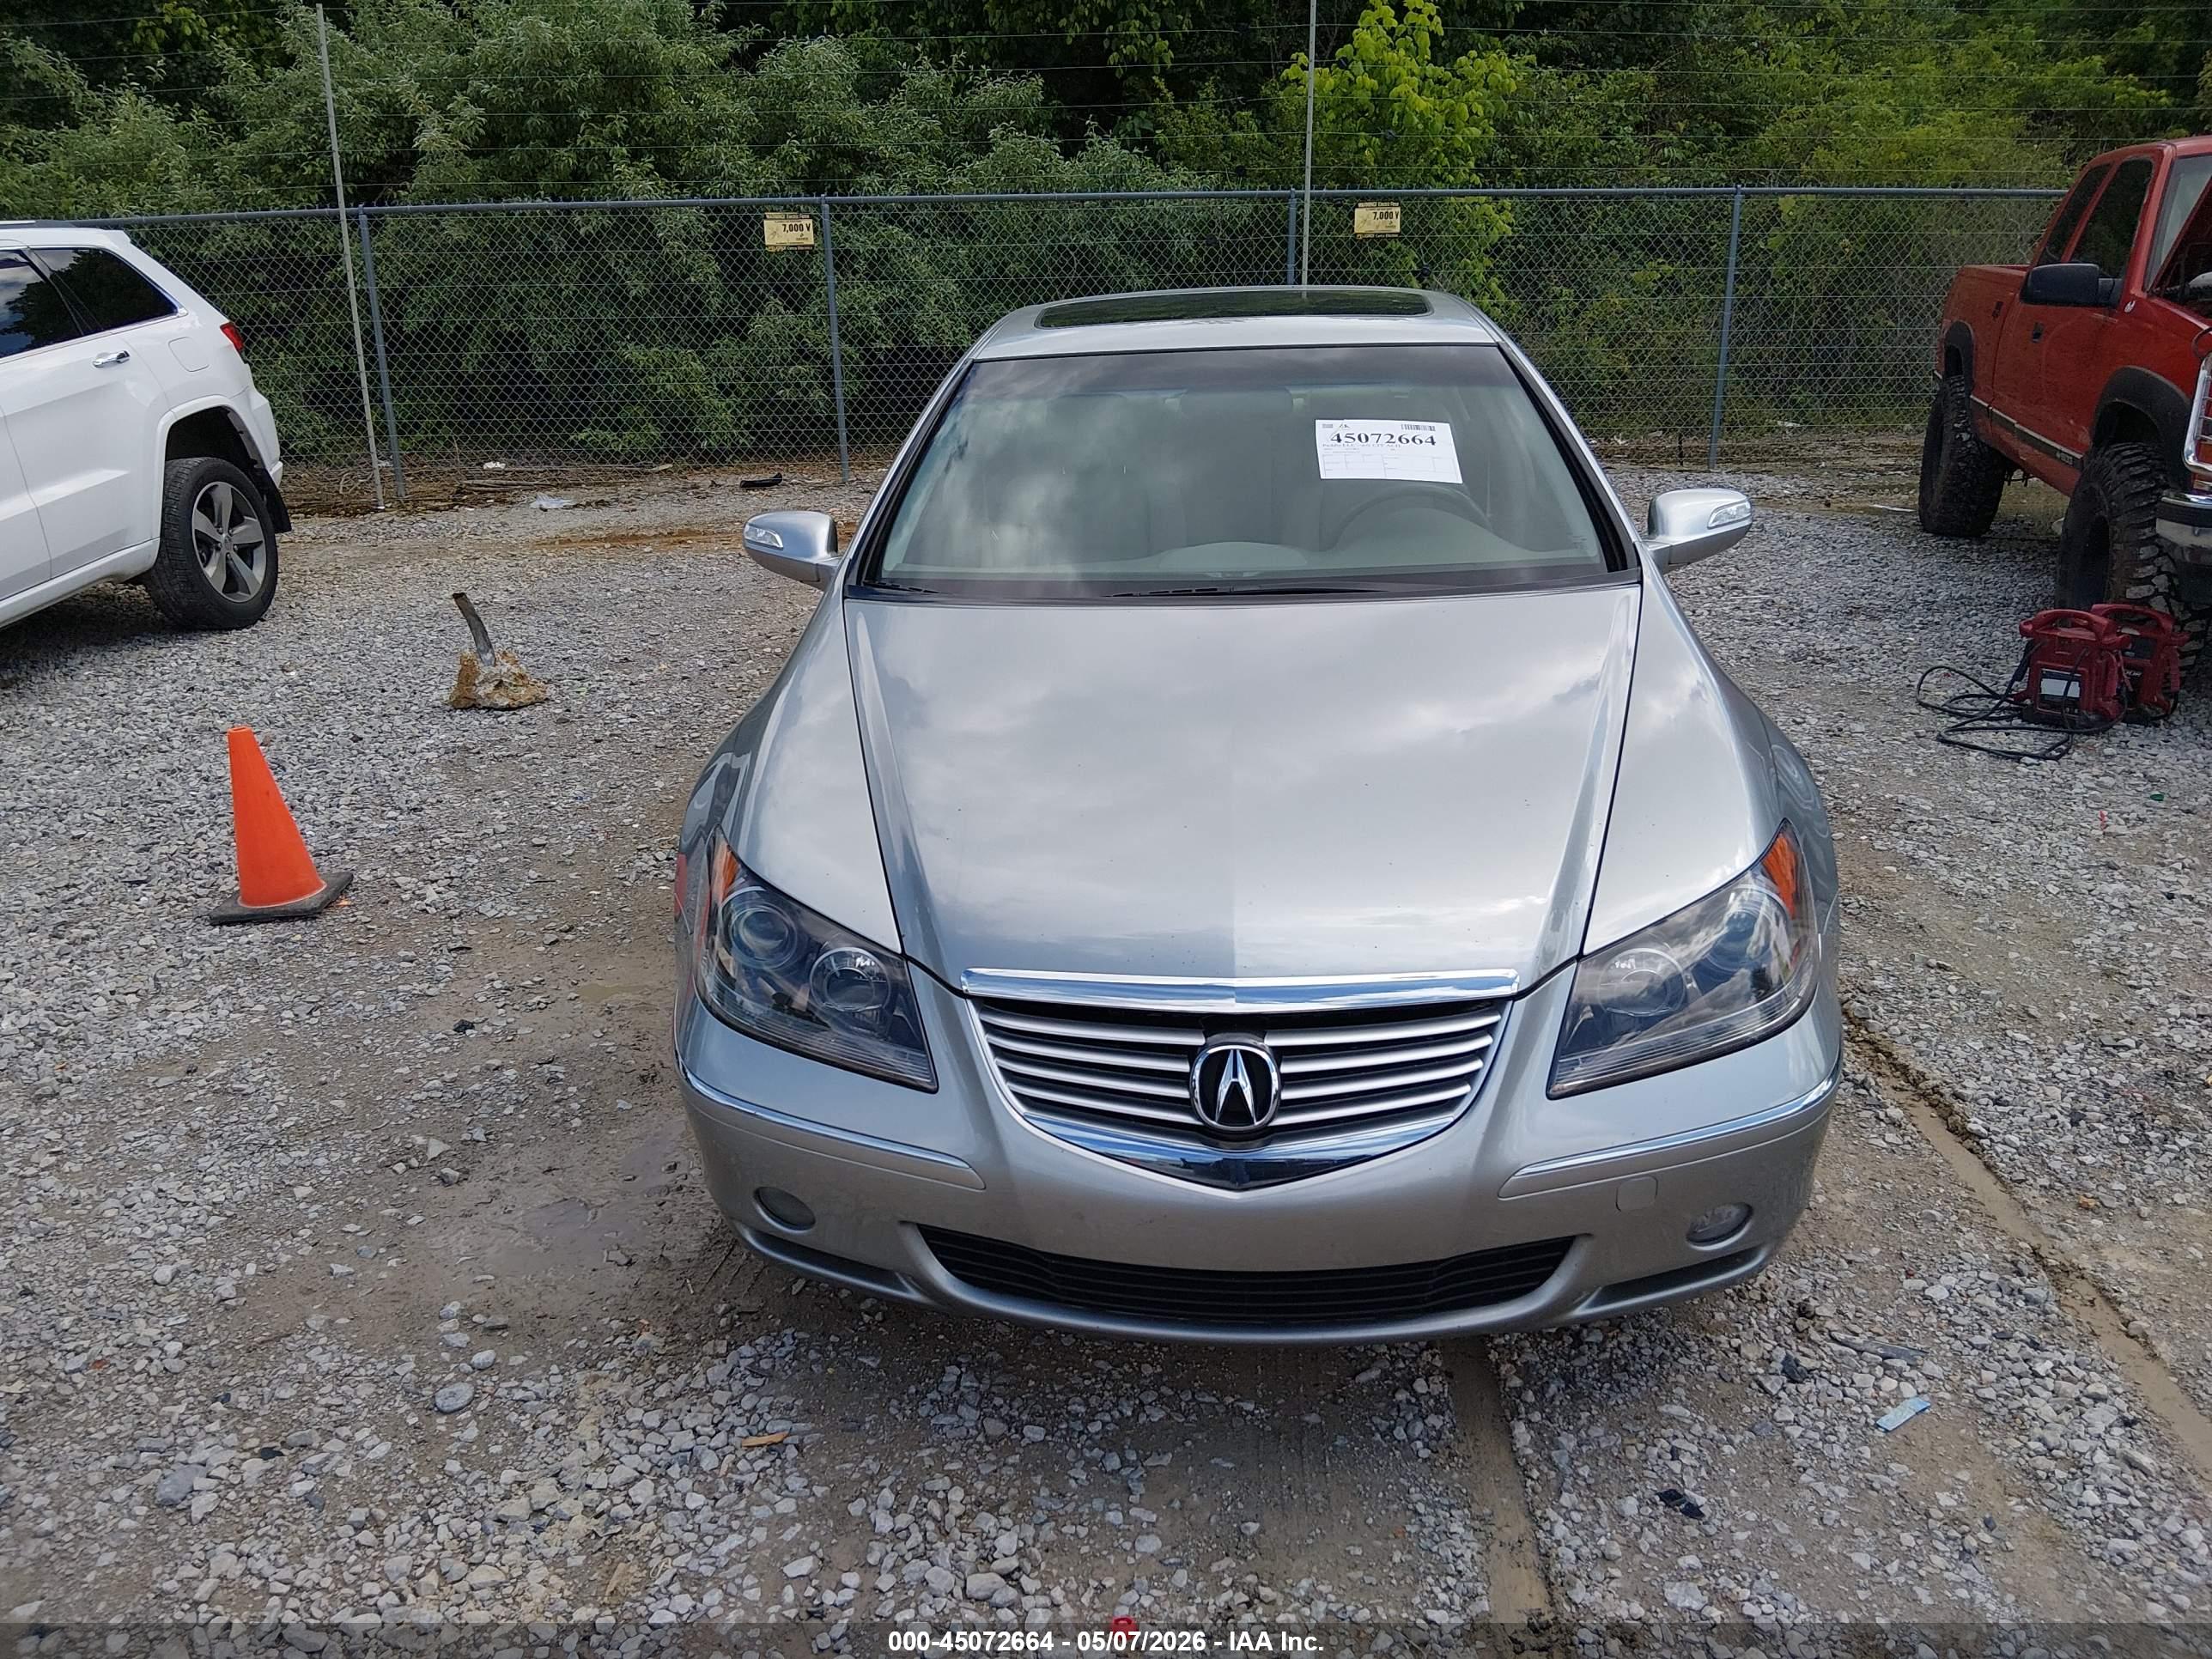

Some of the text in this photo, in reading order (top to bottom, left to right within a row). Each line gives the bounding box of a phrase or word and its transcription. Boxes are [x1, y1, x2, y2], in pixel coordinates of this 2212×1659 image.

[1372, 211, 1400, 221] 7,000 V
[782, 222, 811, 234] 7,000 V
[1330, 432, 1437, 446] 45072664
